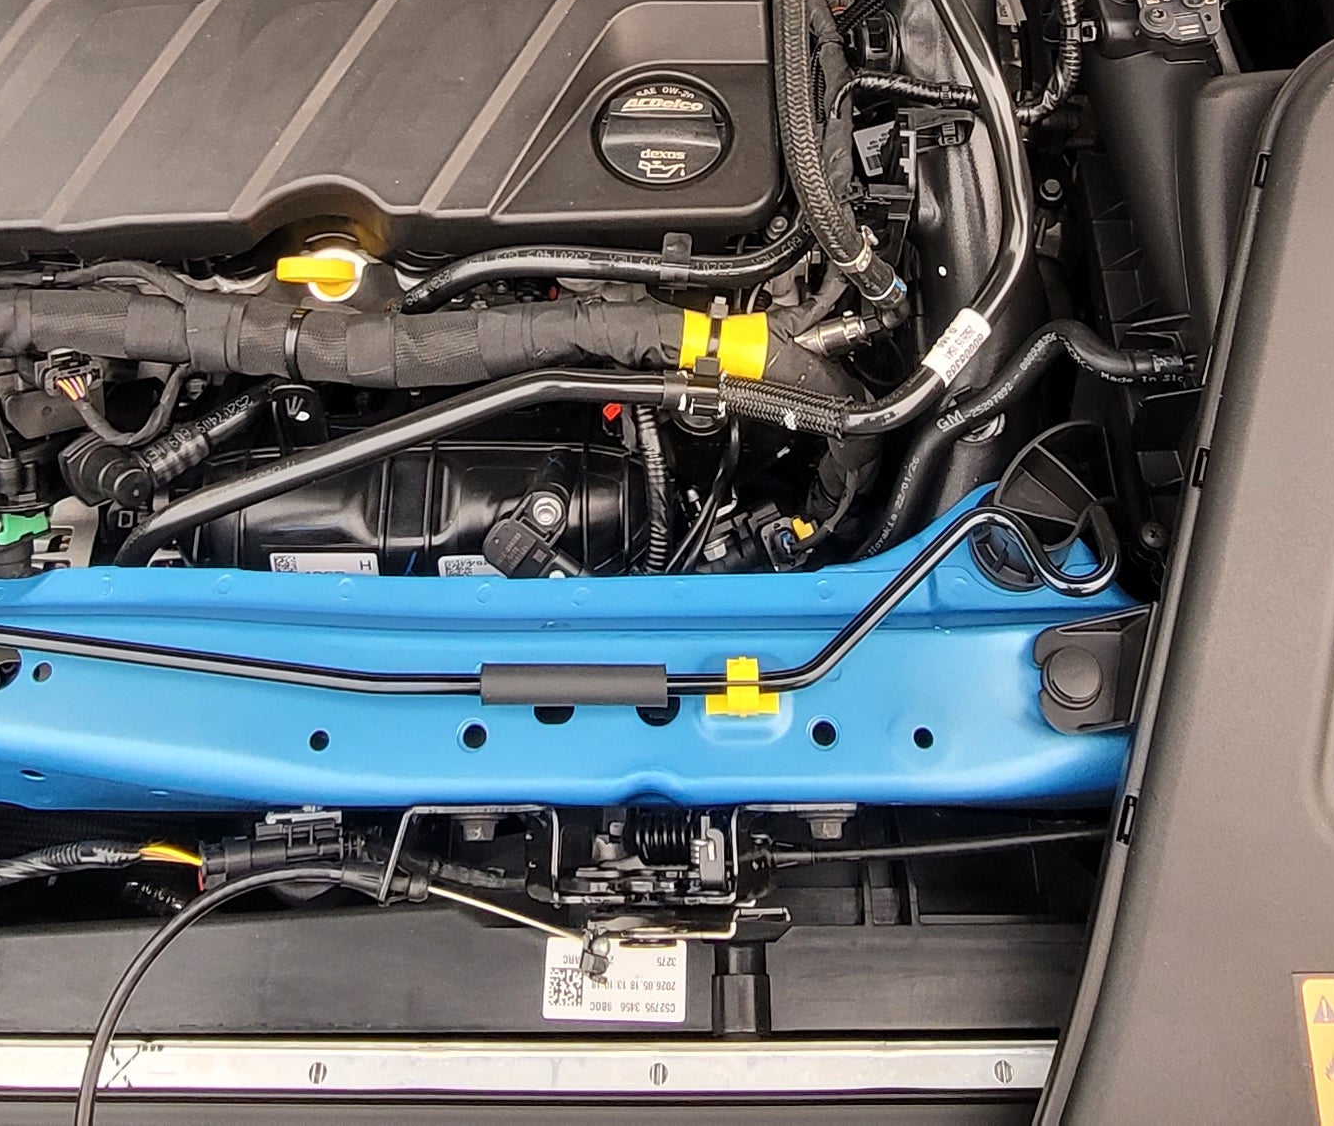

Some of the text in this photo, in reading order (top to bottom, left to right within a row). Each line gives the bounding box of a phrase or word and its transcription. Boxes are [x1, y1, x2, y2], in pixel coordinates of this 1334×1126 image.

[635, 87, 657, 97] SAE
[620, 97, 704, 113] ACDelco
[640, 148, 687, 160] dexos
[359, 559, 372, 571] H
[620, 1002, 641, 1013] 3456
